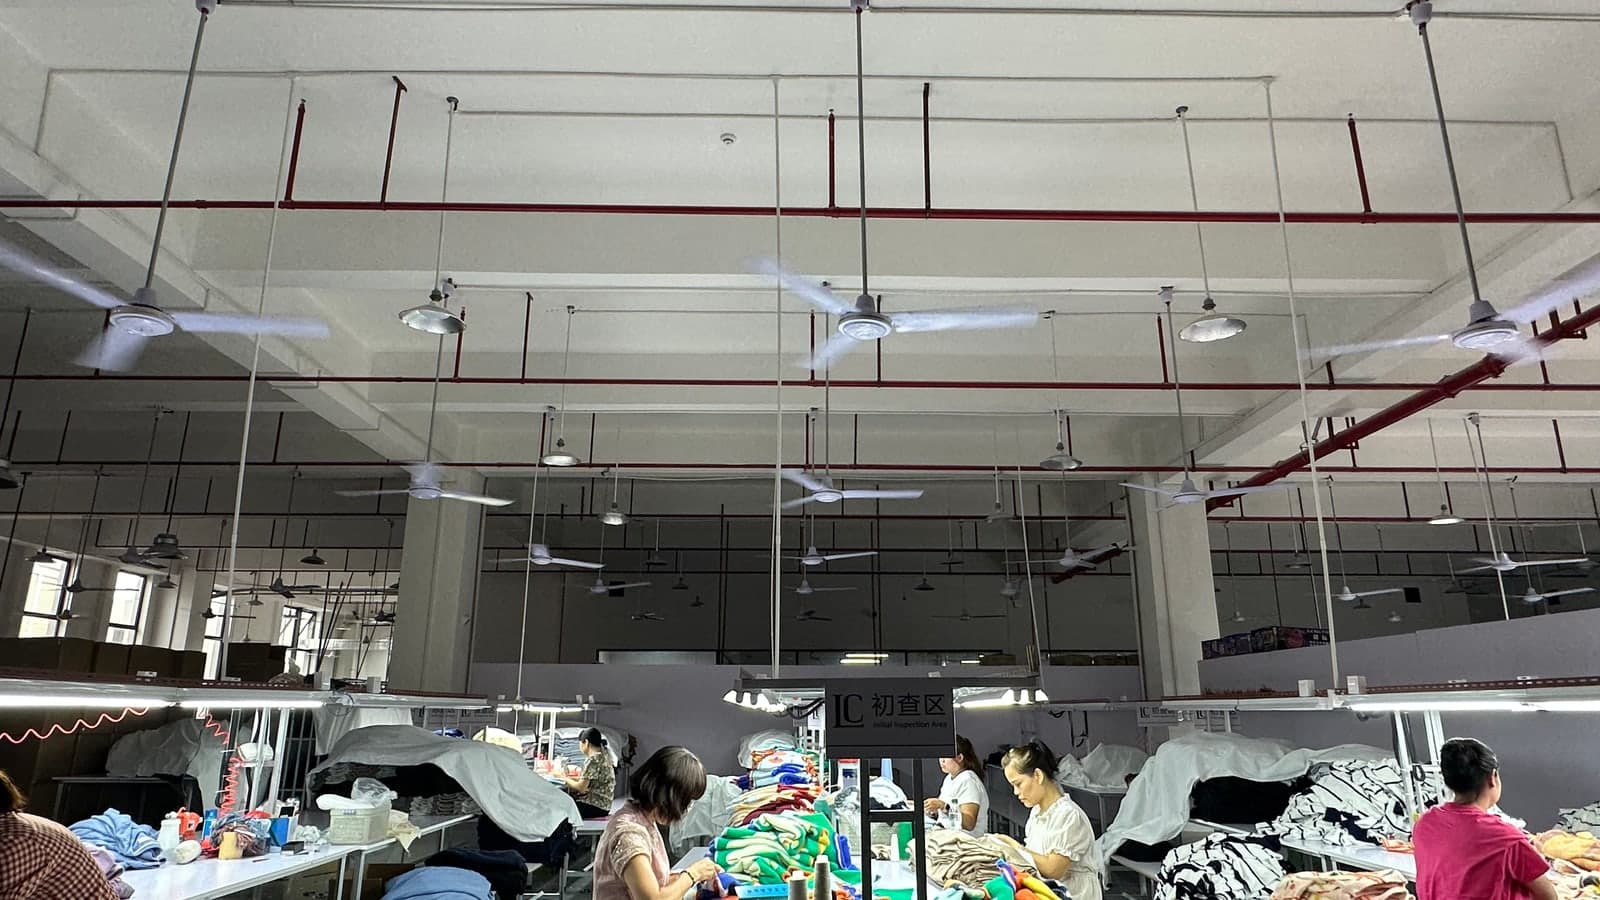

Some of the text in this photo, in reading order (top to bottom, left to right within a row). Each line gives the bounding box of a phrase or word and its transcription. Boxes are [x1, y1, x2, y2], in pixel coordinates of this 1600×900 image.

[832, 694, 864, 728] LC
[872, 692, 946, 718] 初查区
[873, 720, 947, 729] Initial Inspection Area
